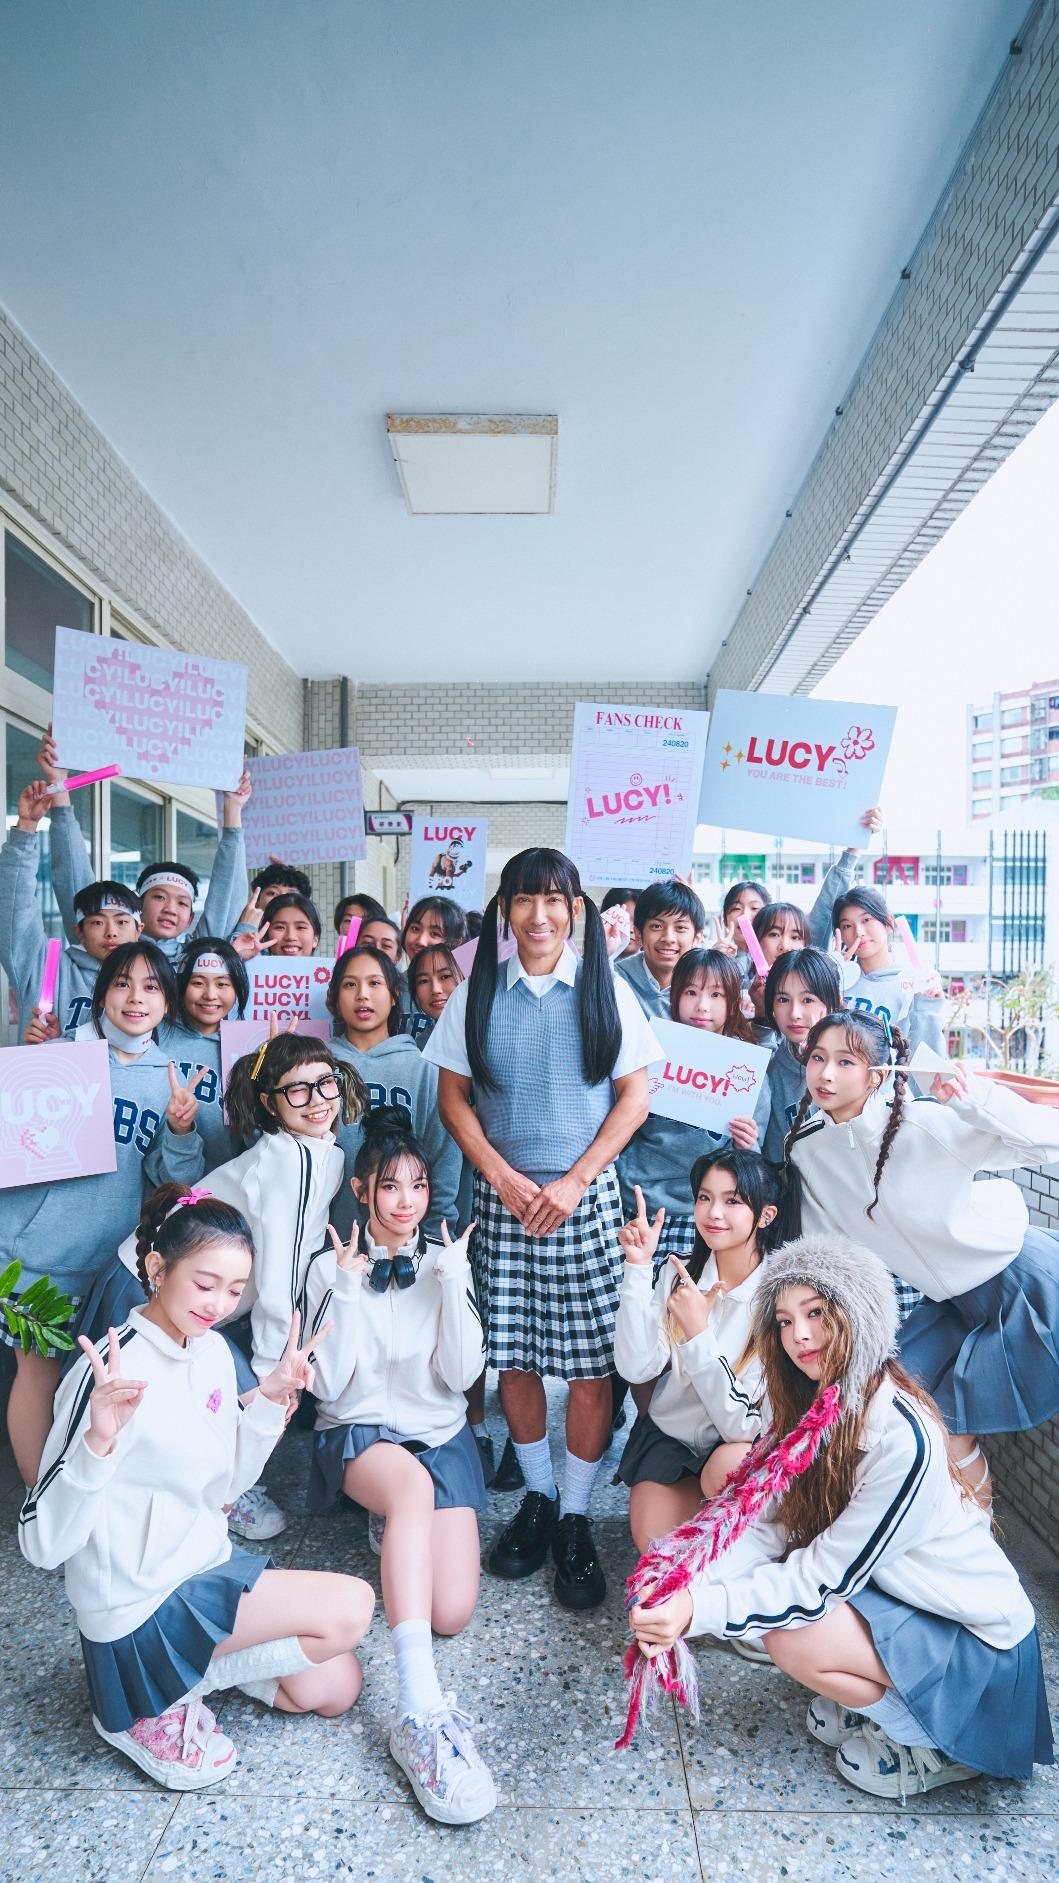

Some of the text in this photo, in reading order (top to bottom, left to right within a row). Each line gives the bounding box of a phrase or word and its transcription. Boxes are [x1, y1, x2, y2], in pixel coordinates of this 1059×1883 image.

[596, 711, 631, 727] FANS
[634, 714, 683, 731] CHECK
[662, 739, 689, 748] 240820
[746, 736, 837, 772] LUCY
[746, 767, 848, 790] YOU ARE THE BEST!
[586, 783, 672, 818] LUCY!
[423, 826, 477, 842] LUCY
[649, 867, 675, 875] 240820
[197, 959, 225, 968] LUCY
[254, 974, 310, 989] LUCY!
[253, 992, 309, 1007] LUCY!
[662, 1061, 731, 1097] LUCY!
